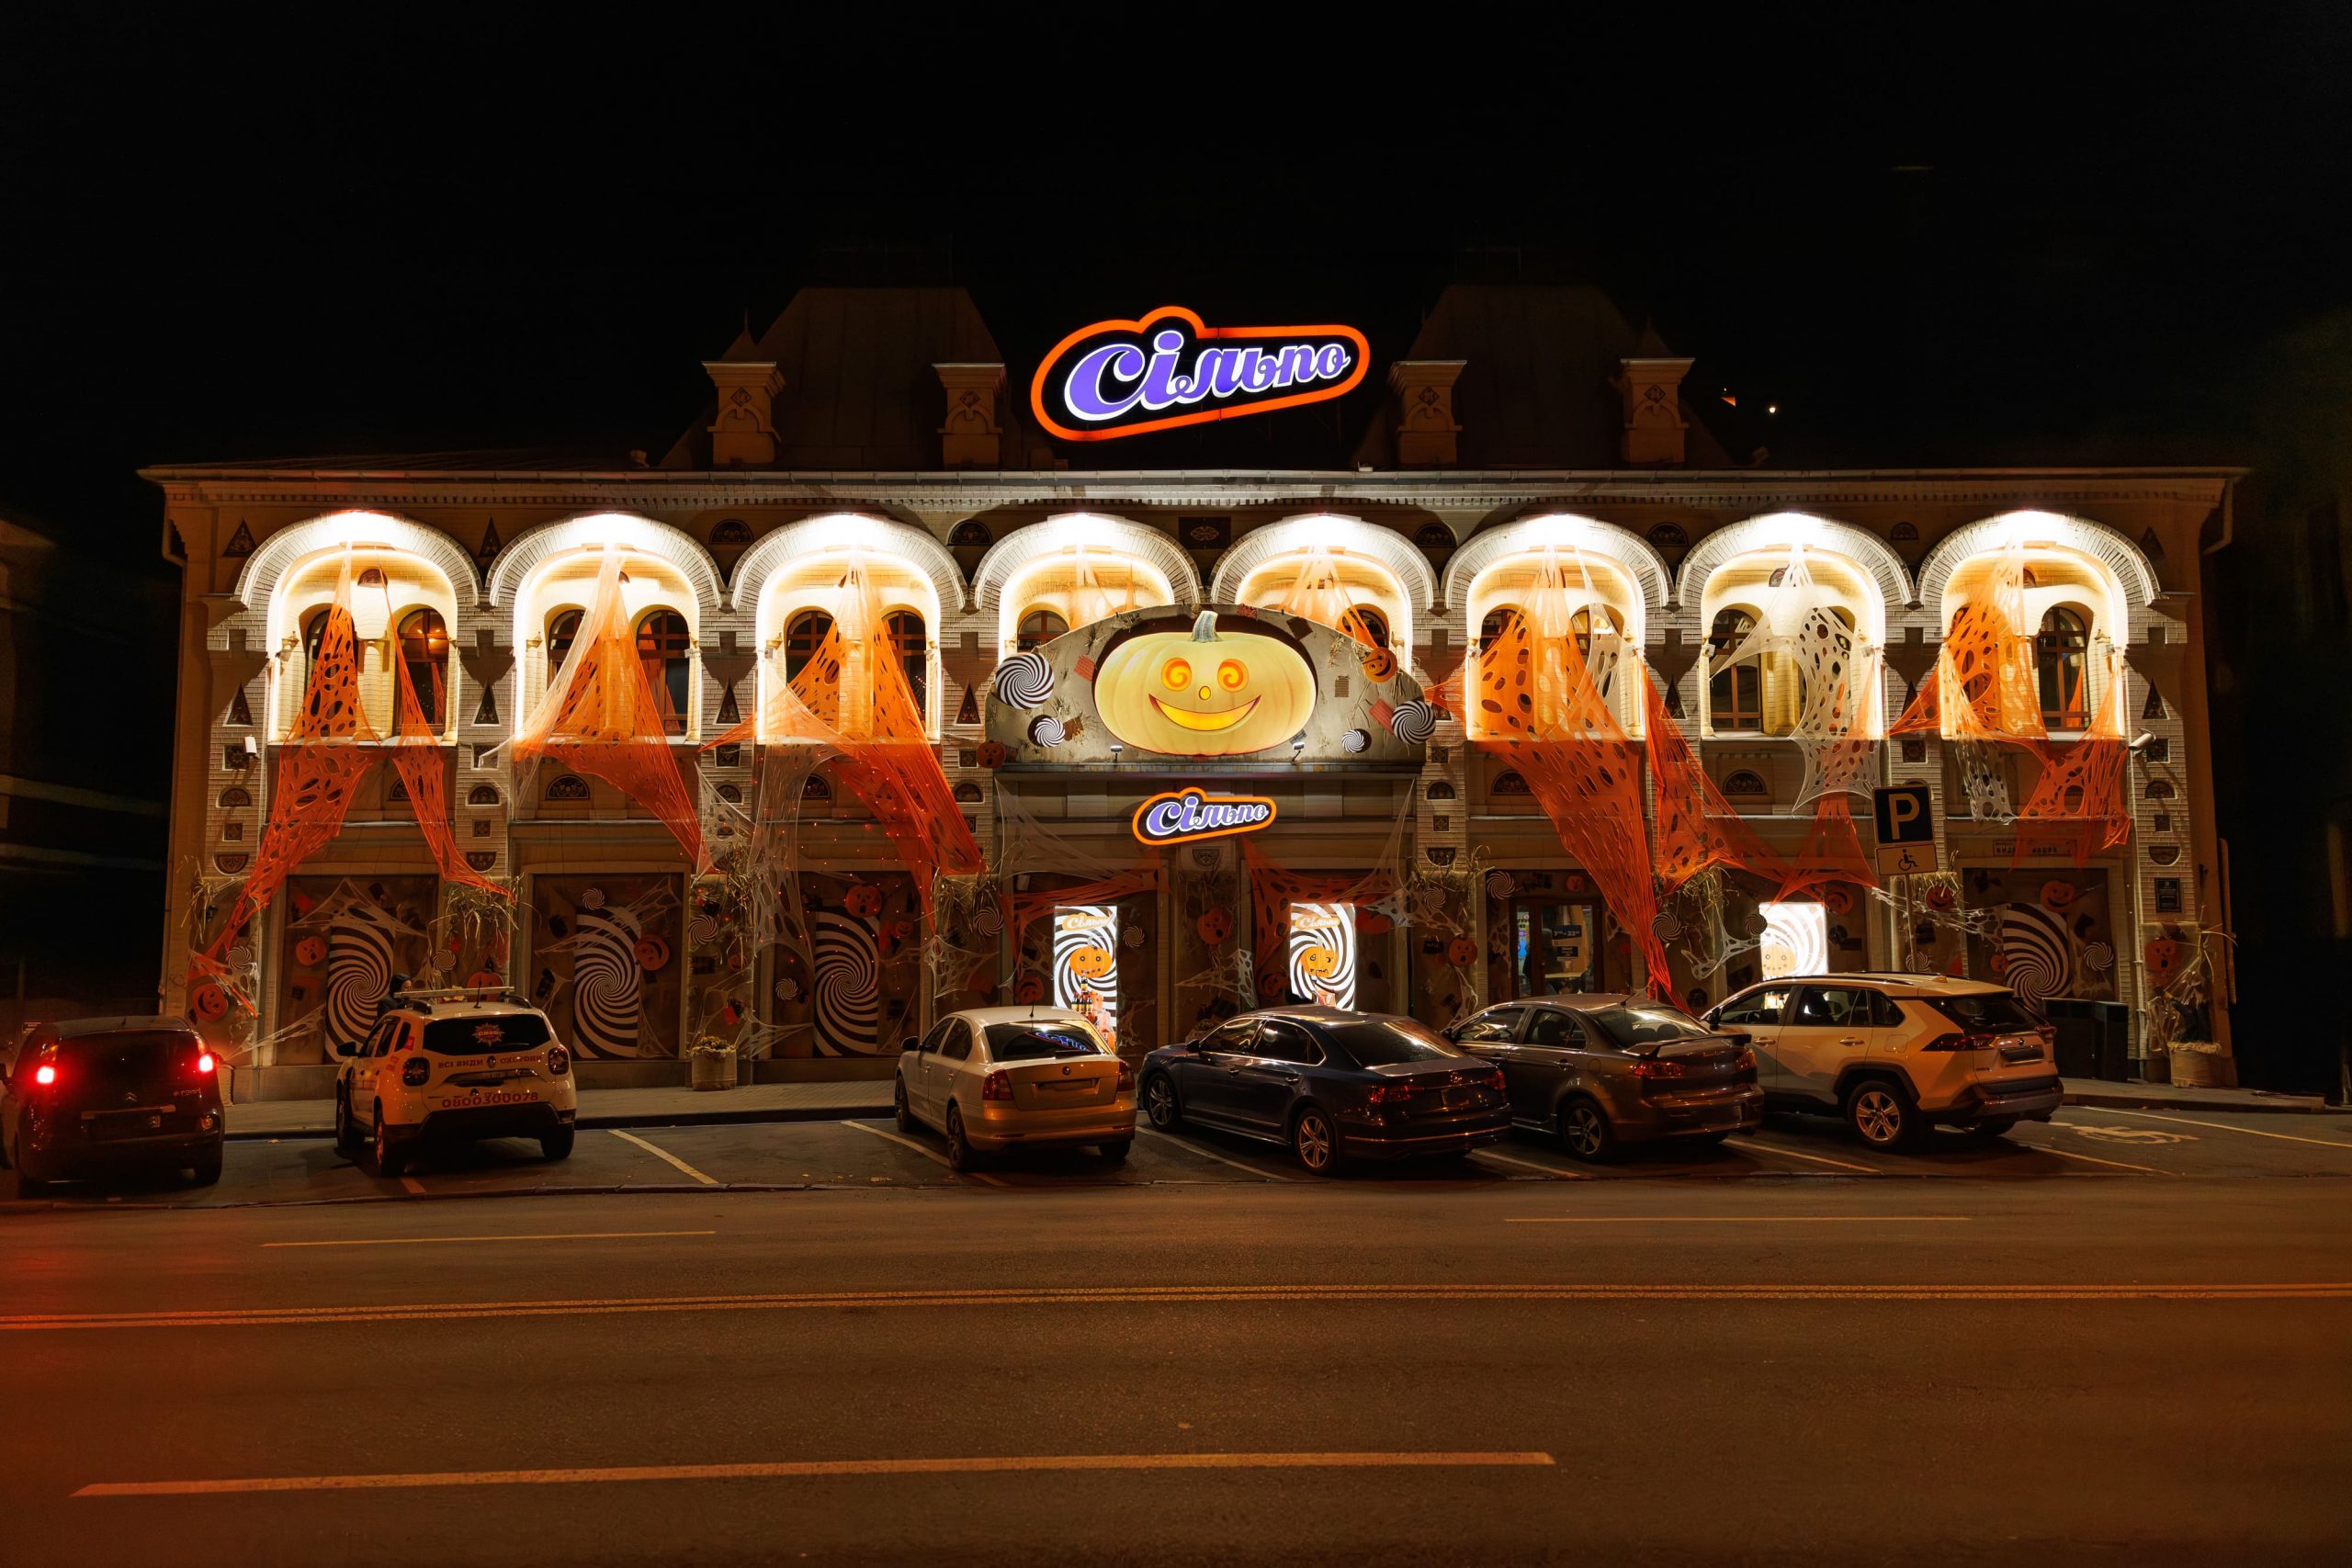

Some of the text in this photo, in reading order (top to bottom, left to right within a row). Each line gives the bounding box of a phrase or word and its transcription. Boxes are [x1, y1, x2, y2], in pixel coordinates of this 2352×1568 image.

[1064, 330, 1351, 422] Сільпо
[1147, 795, 1269, 836] Сільпо
[1889, 793, 1919, 840] P
